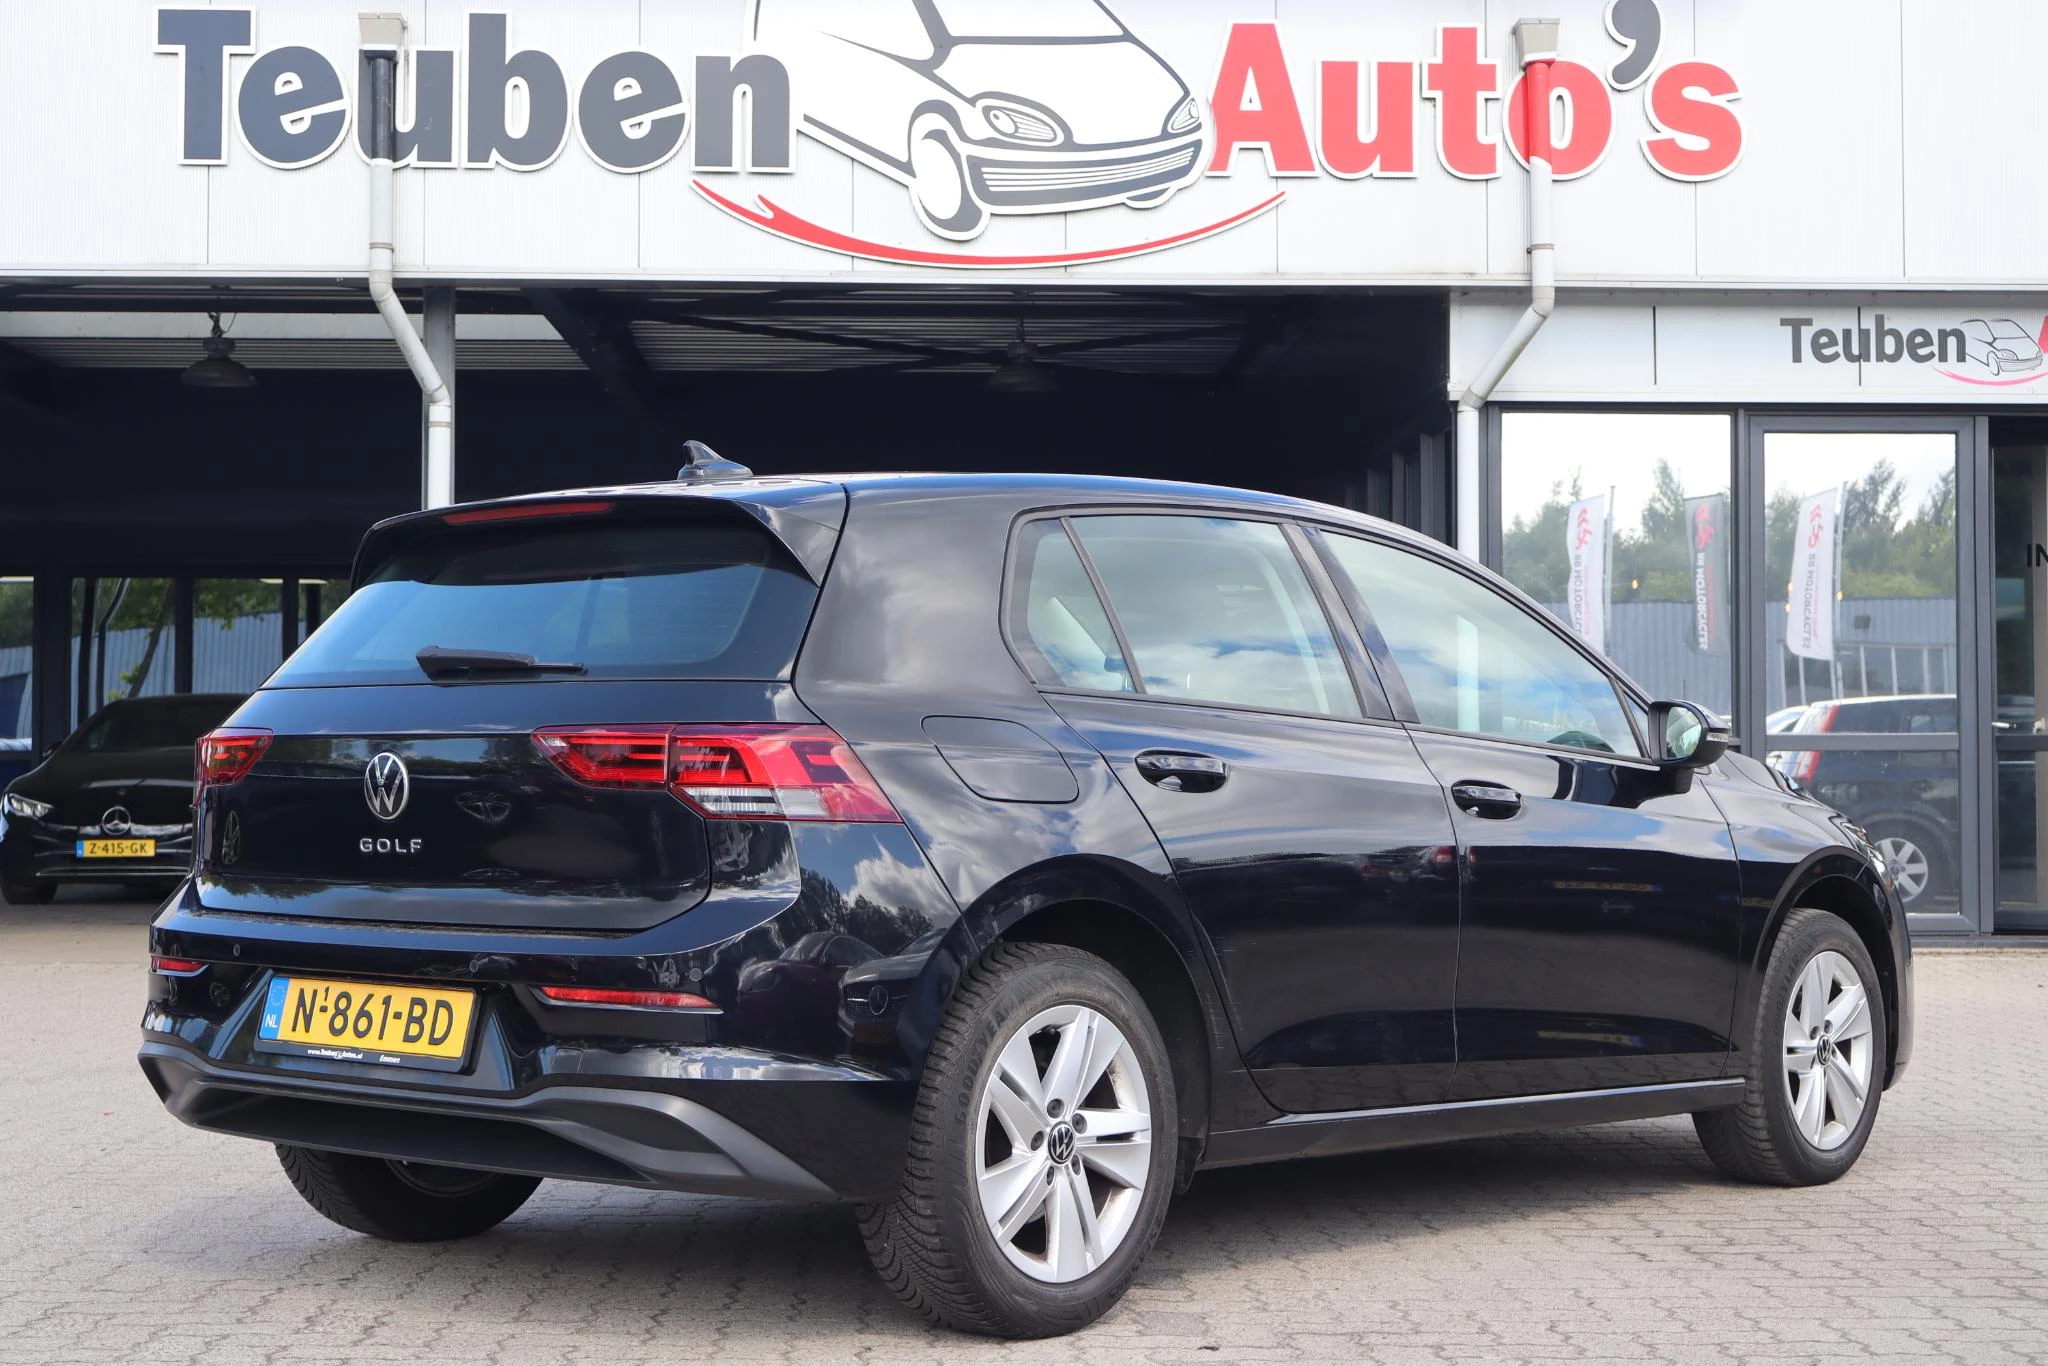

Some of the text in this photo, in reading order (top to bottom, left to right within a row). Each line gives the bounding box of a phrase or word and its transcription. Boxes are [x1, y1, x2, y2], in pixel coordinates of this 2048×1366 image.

[156, 0, 1744, 177] Teuben Auto's
[1779, 313, 1967, 364] Teuben
[89, 842, 148, 855] Z-415-GK
[359, 837, 422, 854] GOLF
[264, 1014, 278, 1029] NL
[379, 1054, 401, 1064] Emmen
